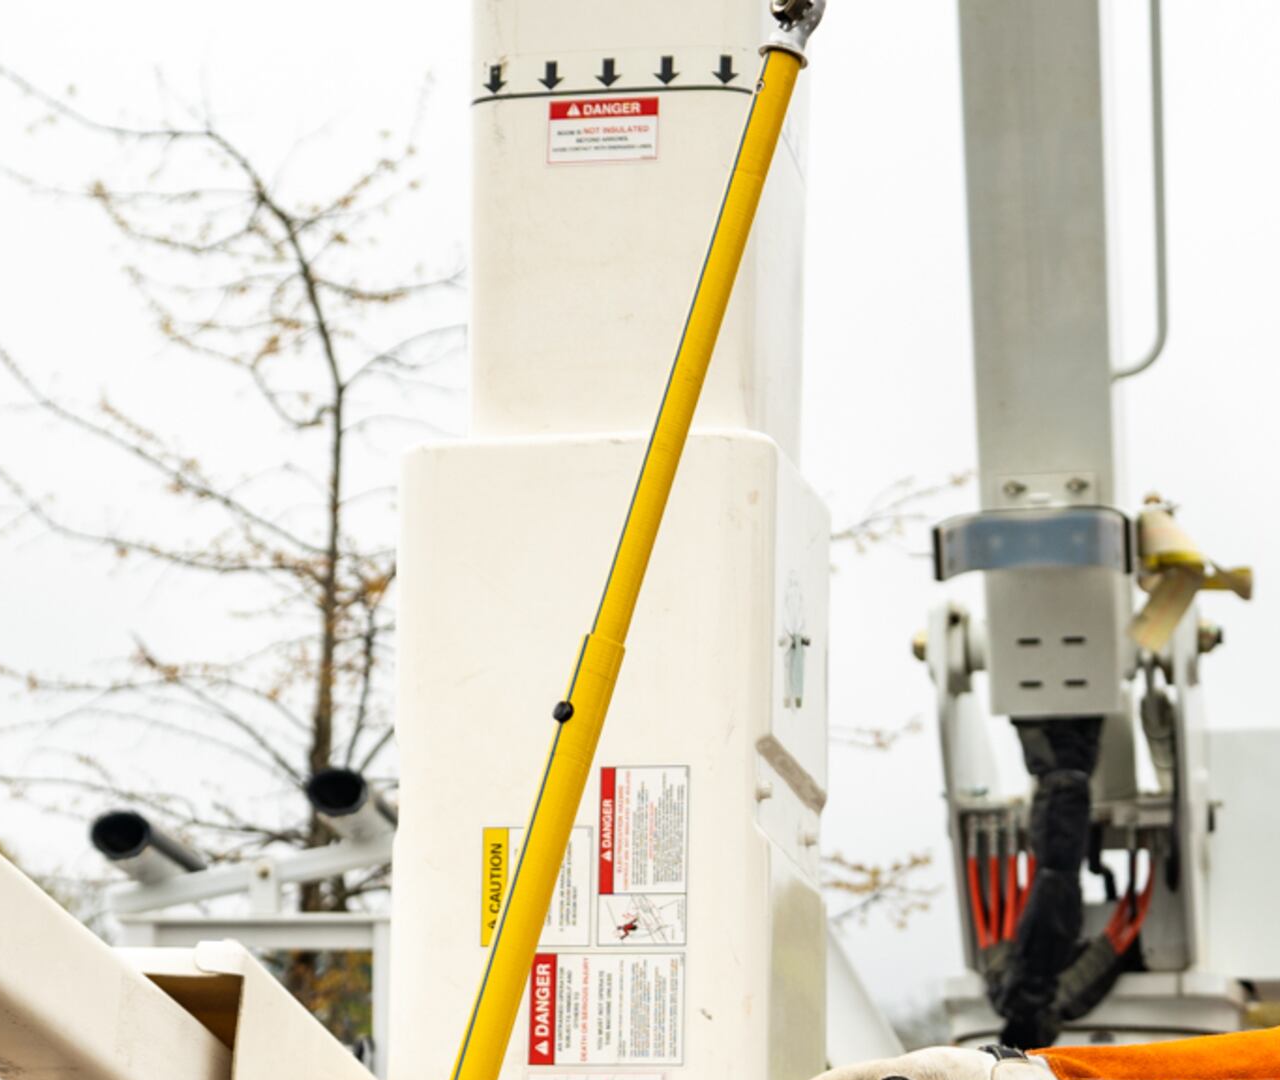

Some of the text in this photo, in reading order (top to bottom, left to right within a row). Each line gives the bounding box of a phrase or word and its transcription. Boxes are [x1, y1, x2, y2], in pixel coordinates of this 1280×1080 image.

[583, 102, 641, 115] DANGER
[601, 799, 613, 849] DANGER
[489, 843, 502, 914] CAUTION
[534, 963, 551, 1037] DANGER
